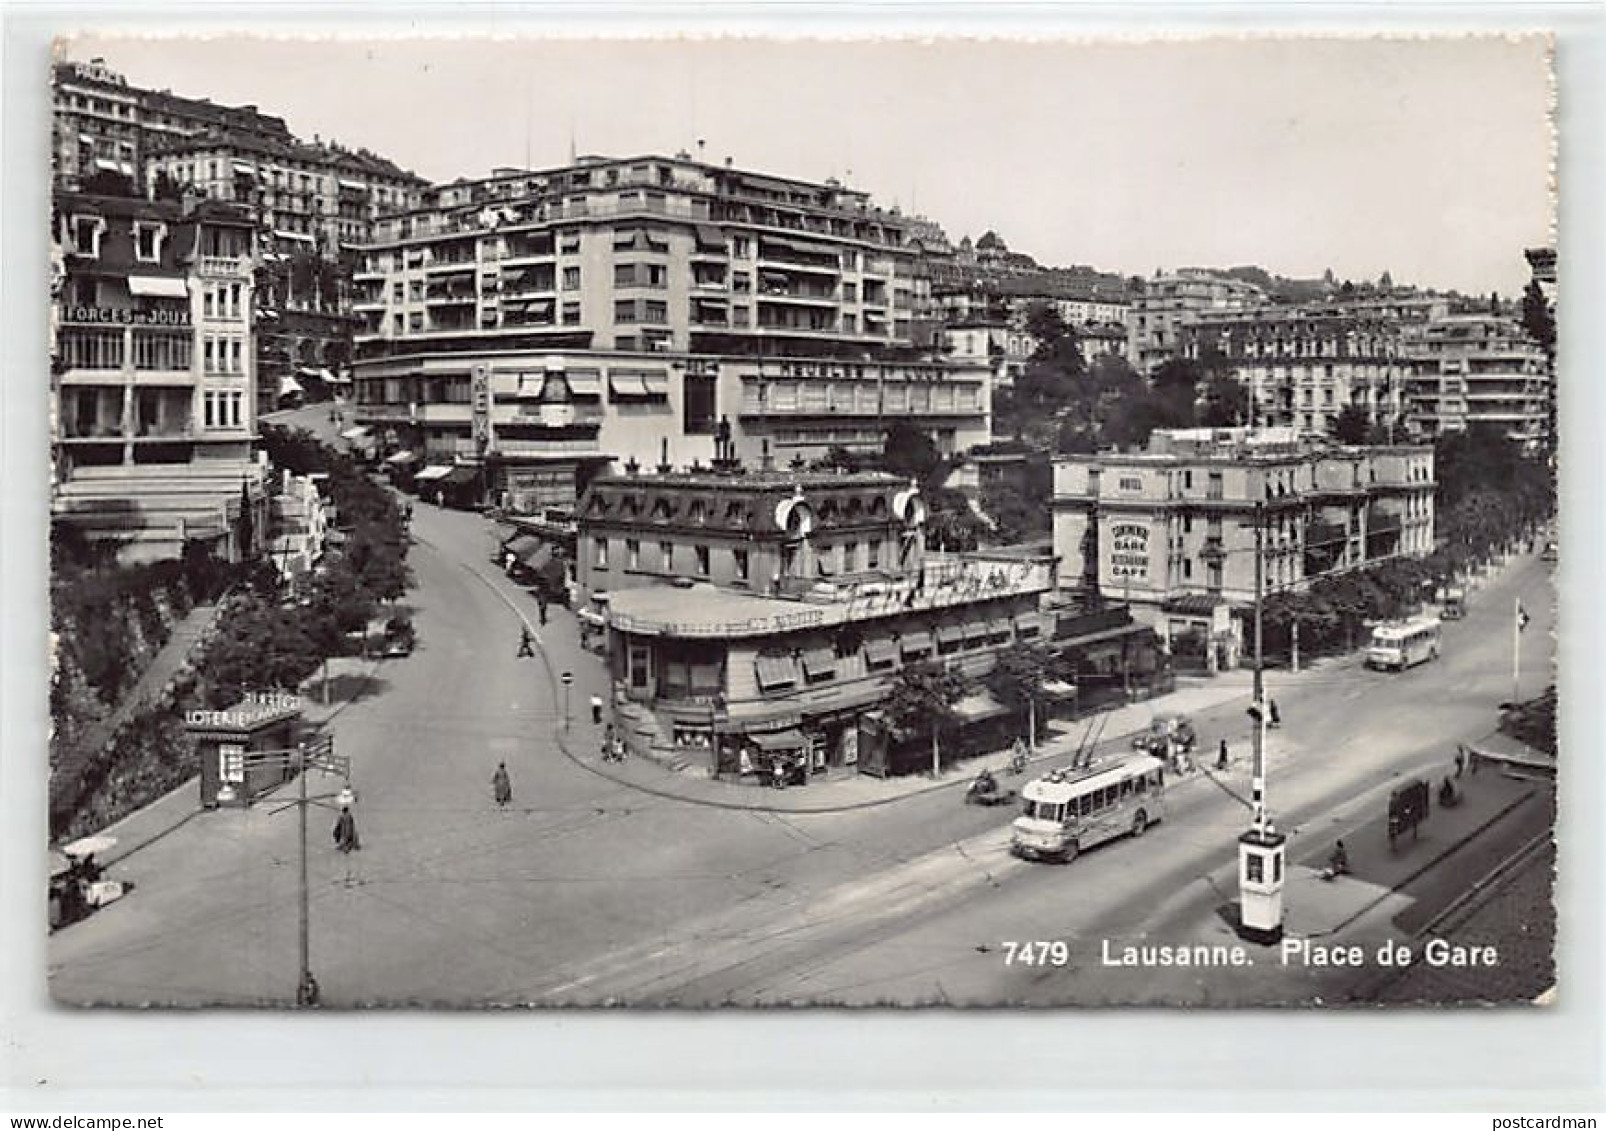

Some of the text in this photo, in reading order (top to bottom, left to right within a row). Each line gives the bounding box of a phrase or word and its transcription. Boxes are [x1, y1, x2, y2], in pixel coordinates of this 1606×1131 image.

[75, 64, 126, 86] PALACE
[66, 306, 132, 323] FORCES
[148, 310, 189, 325] JOUX
[185, 710, 245, 727] LOTERIE
